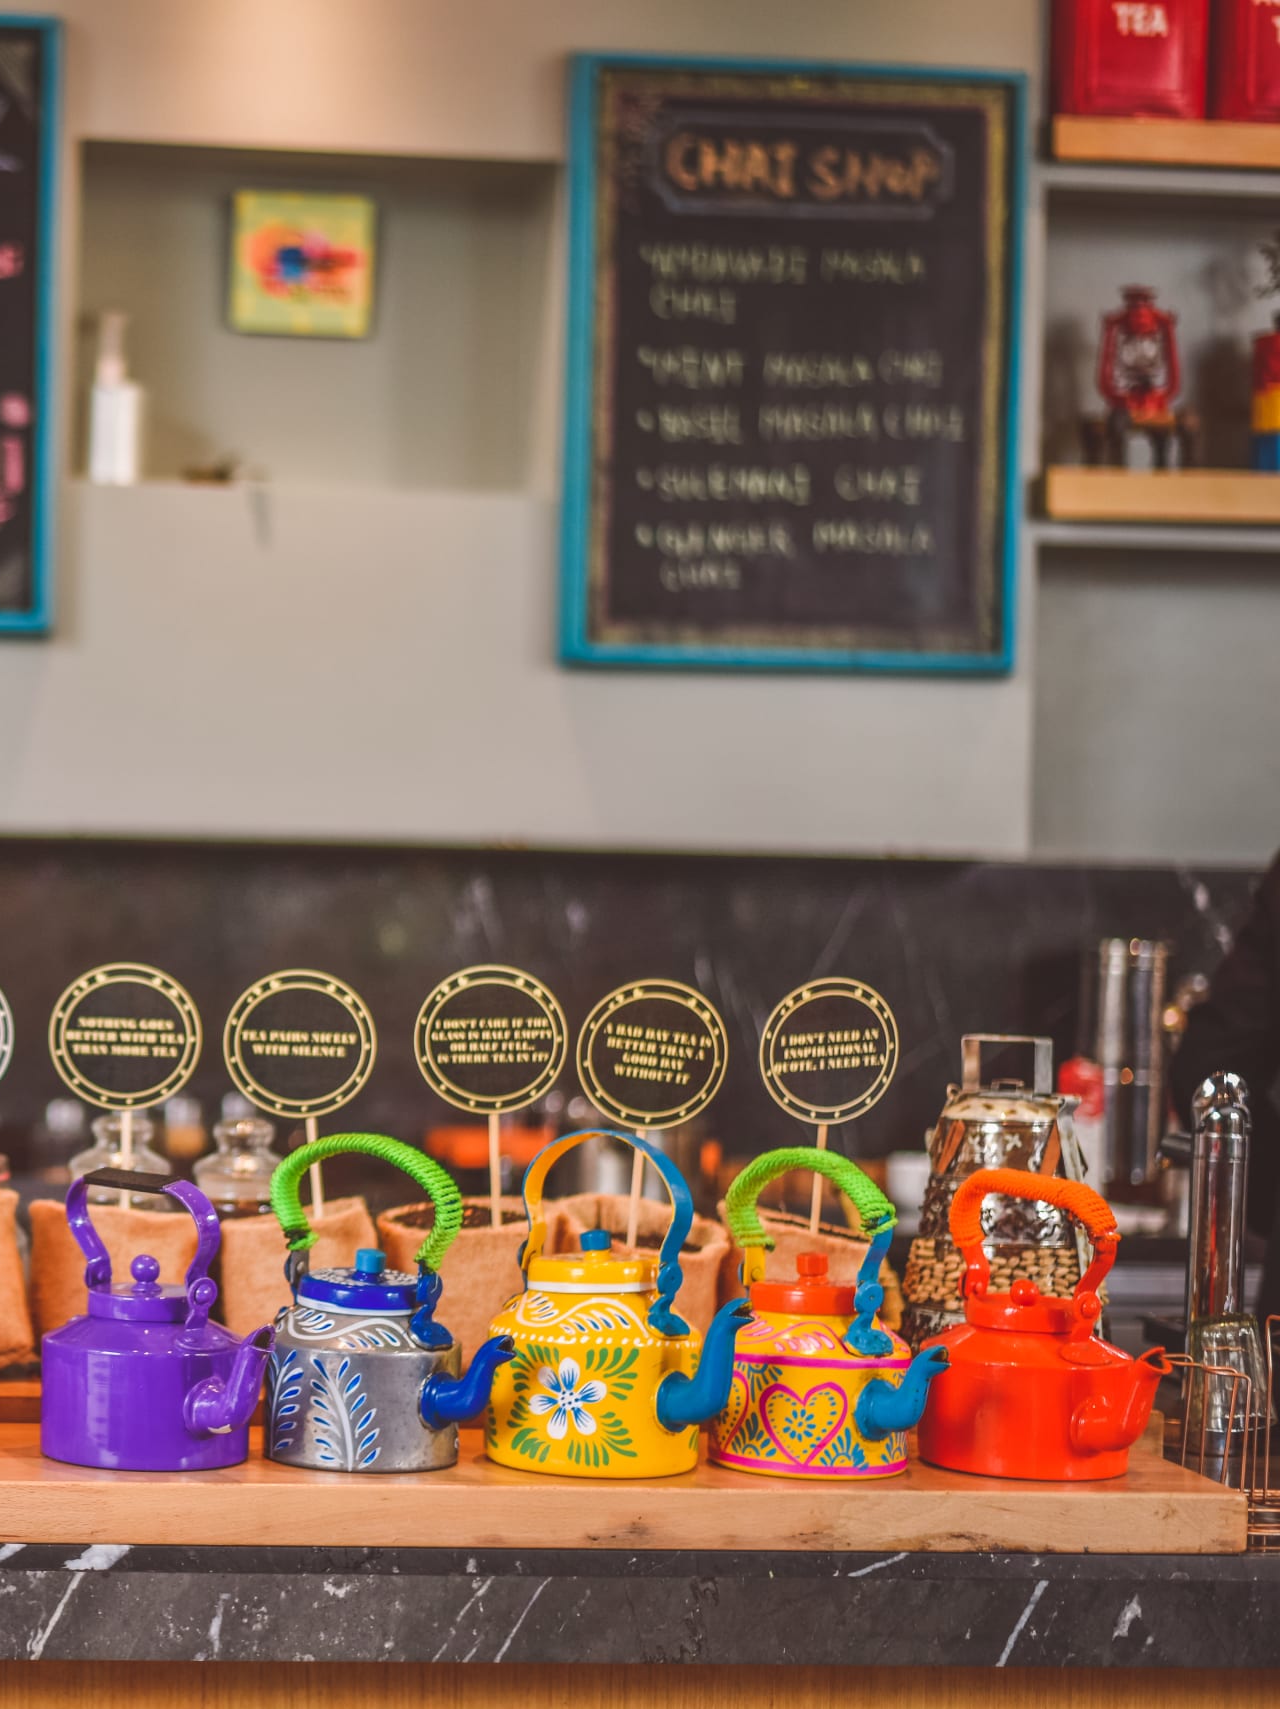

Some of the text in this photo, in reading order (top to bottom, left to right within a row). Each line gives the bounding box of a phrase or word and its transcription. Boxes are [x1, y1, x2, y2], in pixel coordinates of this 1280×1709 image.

[1113, 2, 1167, 37] TEA
[665, 132, 797, 197] CHAI
[78, 1017, 174, 1030] NOTHING GOES
[443, 1018, 477, 1029] DON'T
[479, 1018, 509, 1029] CARE
[512, 1017, 523, 1028] IF
[526, 1017, 549, 1028] THE
[66, 1030, 185, 1044] BETTER WITH TEA
[242, 1030, 358, 1045] TEA PAIRS NICELY
[431, 1029, 553, 1041] GLASS IS HALF EMPTY
[604, 1022, 713, 1048] A BAD DAY TEA IS
[789, 1032, 825, 1046] DON'T
[827, 1029, 861, 1043] NEED
[863, 1027, 880, 1041] AN
[111, 1045, 149, 1056] MORE
[152, 1047, 178, 1058] TEA
[252, 1044, 346, 1058] WITH SILENCE
[450, 1042, 467, 1052] OR
[469, 1042, 499, 1052] HALF
[607, 1036, 705, 1061] BETTER THAN A
[784, 1042, 876, 1060] INSPIRATIONAL
[437, 1054, 449, 1064] IS
[451, 1053, 489, 1064] THERE
[492, 1053, 514, 1063] TEA
[516, 1053, 530, 1063] IN
[622, 1052, 685, 1071] GOOD DAY
[827, 1056, 861, 1070] NEED
[862, 1053, 886, 1067] TEA
[614, 1063, 691, 1085] WITHOUT IT
